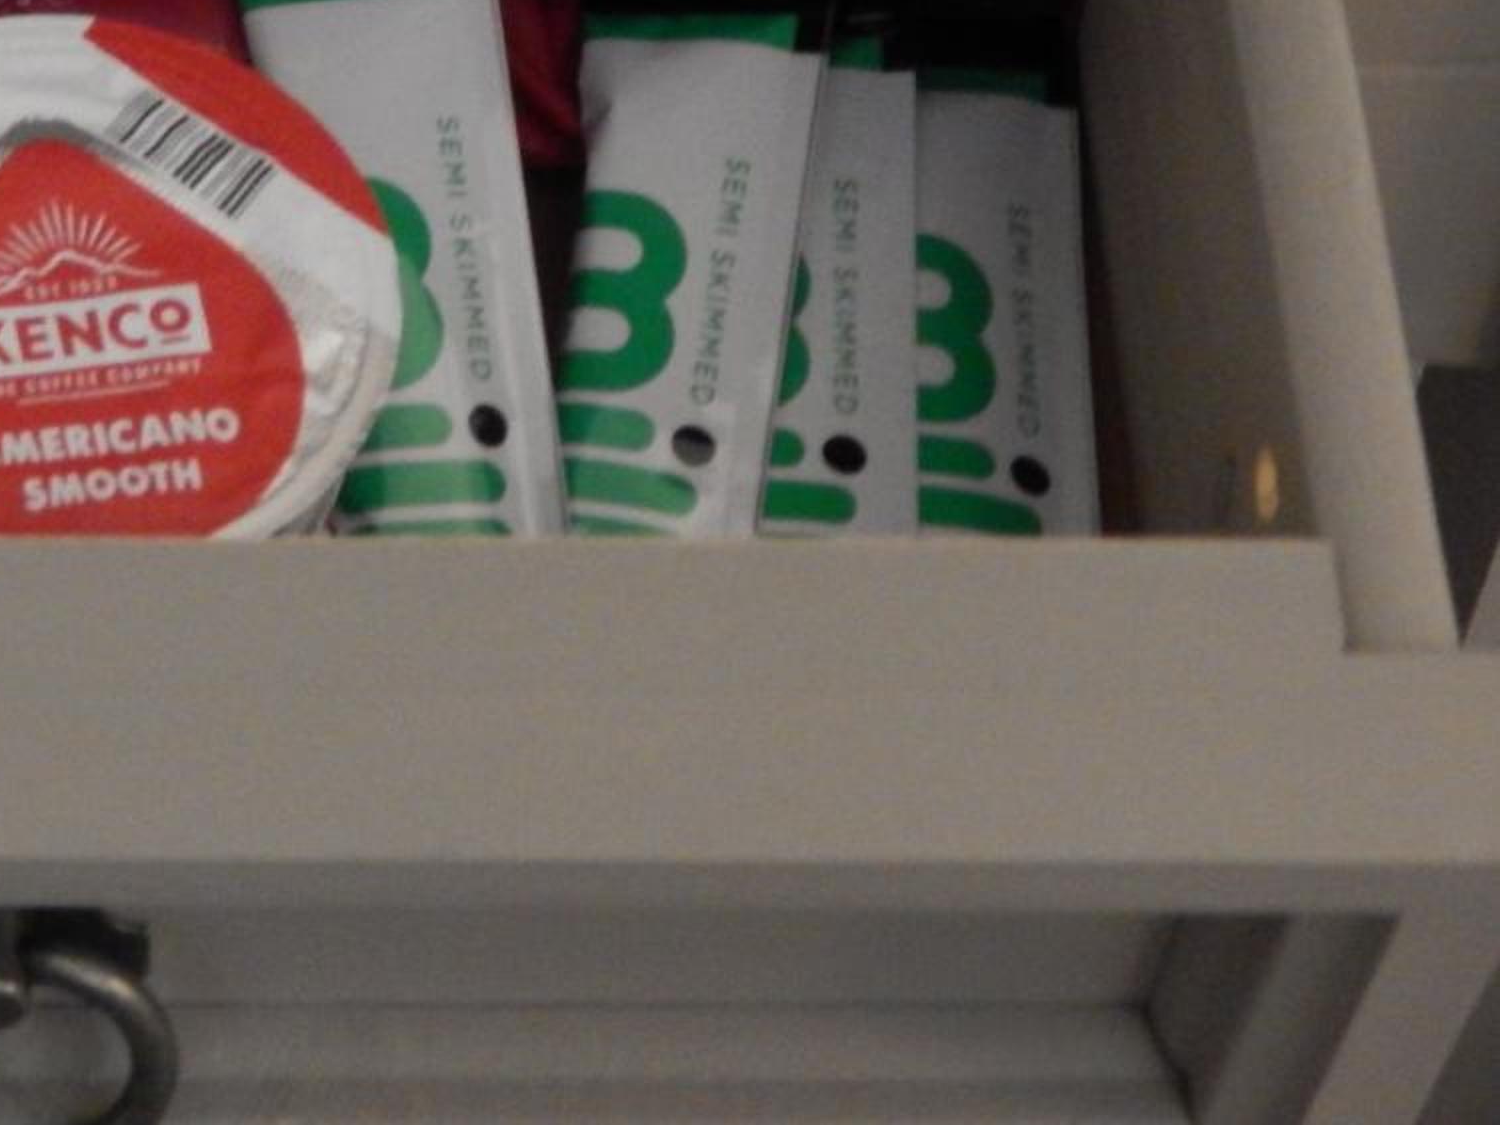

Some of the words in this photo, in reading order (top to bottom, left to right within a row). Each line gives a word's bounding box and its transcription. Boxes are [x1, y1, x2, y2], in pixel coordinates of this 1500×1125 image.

[436, 115, 468, 200] SEMI
[713, 156, 751, 235] SEMI
[832, 178, 860, 254] SEMI
[450, 215, 493, 384] SKIMMED
[689, 249, 736, 408] SKIMMED
[106, 357, 201, 383] COMPANY
[832, 266, 860, 416] SKIMMED
[22, 456, 203, 514] SMOOTH
